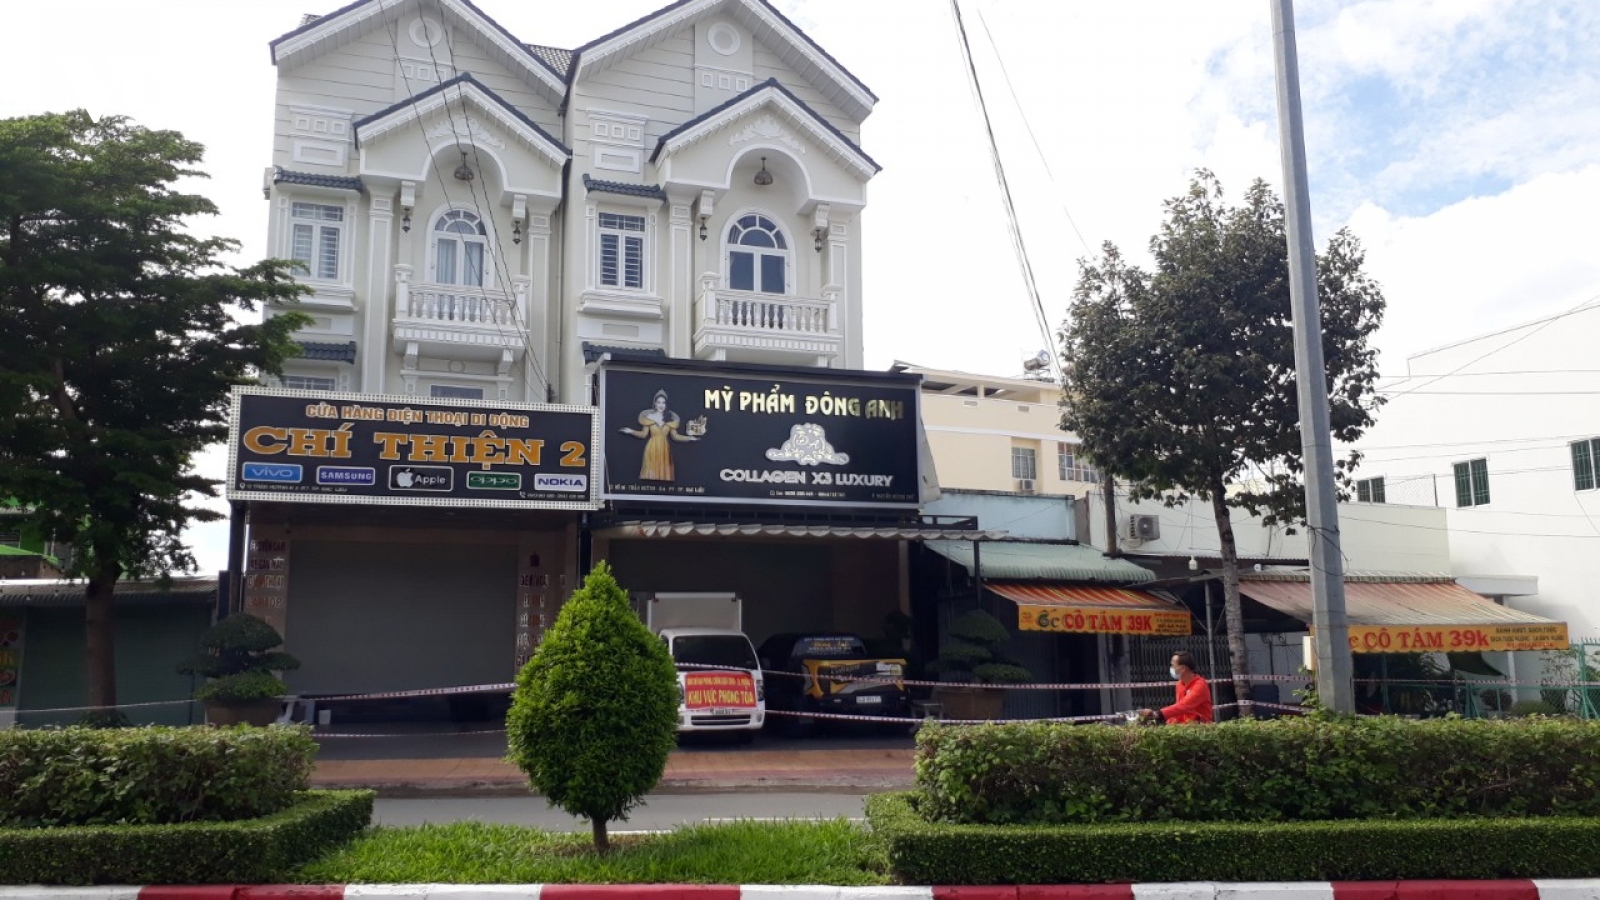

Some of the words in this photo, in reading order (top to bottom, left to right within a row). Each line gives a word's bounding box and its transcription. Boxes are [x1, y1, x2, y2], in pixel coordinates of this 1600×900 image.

[705, 385, 734, 412] MỸ
[739, 384, 795, 414] PHẨM
[805, 390, 861, 417] ĐÔNG
[865, 399, 904, 421] ANH
[306, 401, 339, 419] CỬA
[341, 404, 384, 421] HÀNG
[386, 407, 423, 425] ĐIỆN
[425, 410, 469, 427] THOẠI
[470, 413, 487, 426] DI
[489, 412, 530, 429] ĐỘNG
[243, 422, 355, 458] CHÍ
[373, 429, 545, 471] THIỆN
[559, 441, 586, 467] 2
[251, 466, 294, 478] vivo
[320, 470, 373, 481] SAMSUNG
[414, 475, 446, 485] Apple
[537, 478, 584, 487] NOKIA
[719, 468, 806, 484] COLLAGEN
[811, 471, 833, 485] X3
[835, 472, 894, 488] LUXURY
[1064, 609, 1085, 630] CÔ
[1087, 610, 1123, 631] TÁM
[1127, 614, 1153, 632] 39K
[1363, 627, 1392, 649] CÔ
[1396, 626, 1445, 649] TÁM
[688, 689, 703, 706] KHU
[703, 687, 718, 708] VỰC
[718, 689, 740, 705] PHONG
